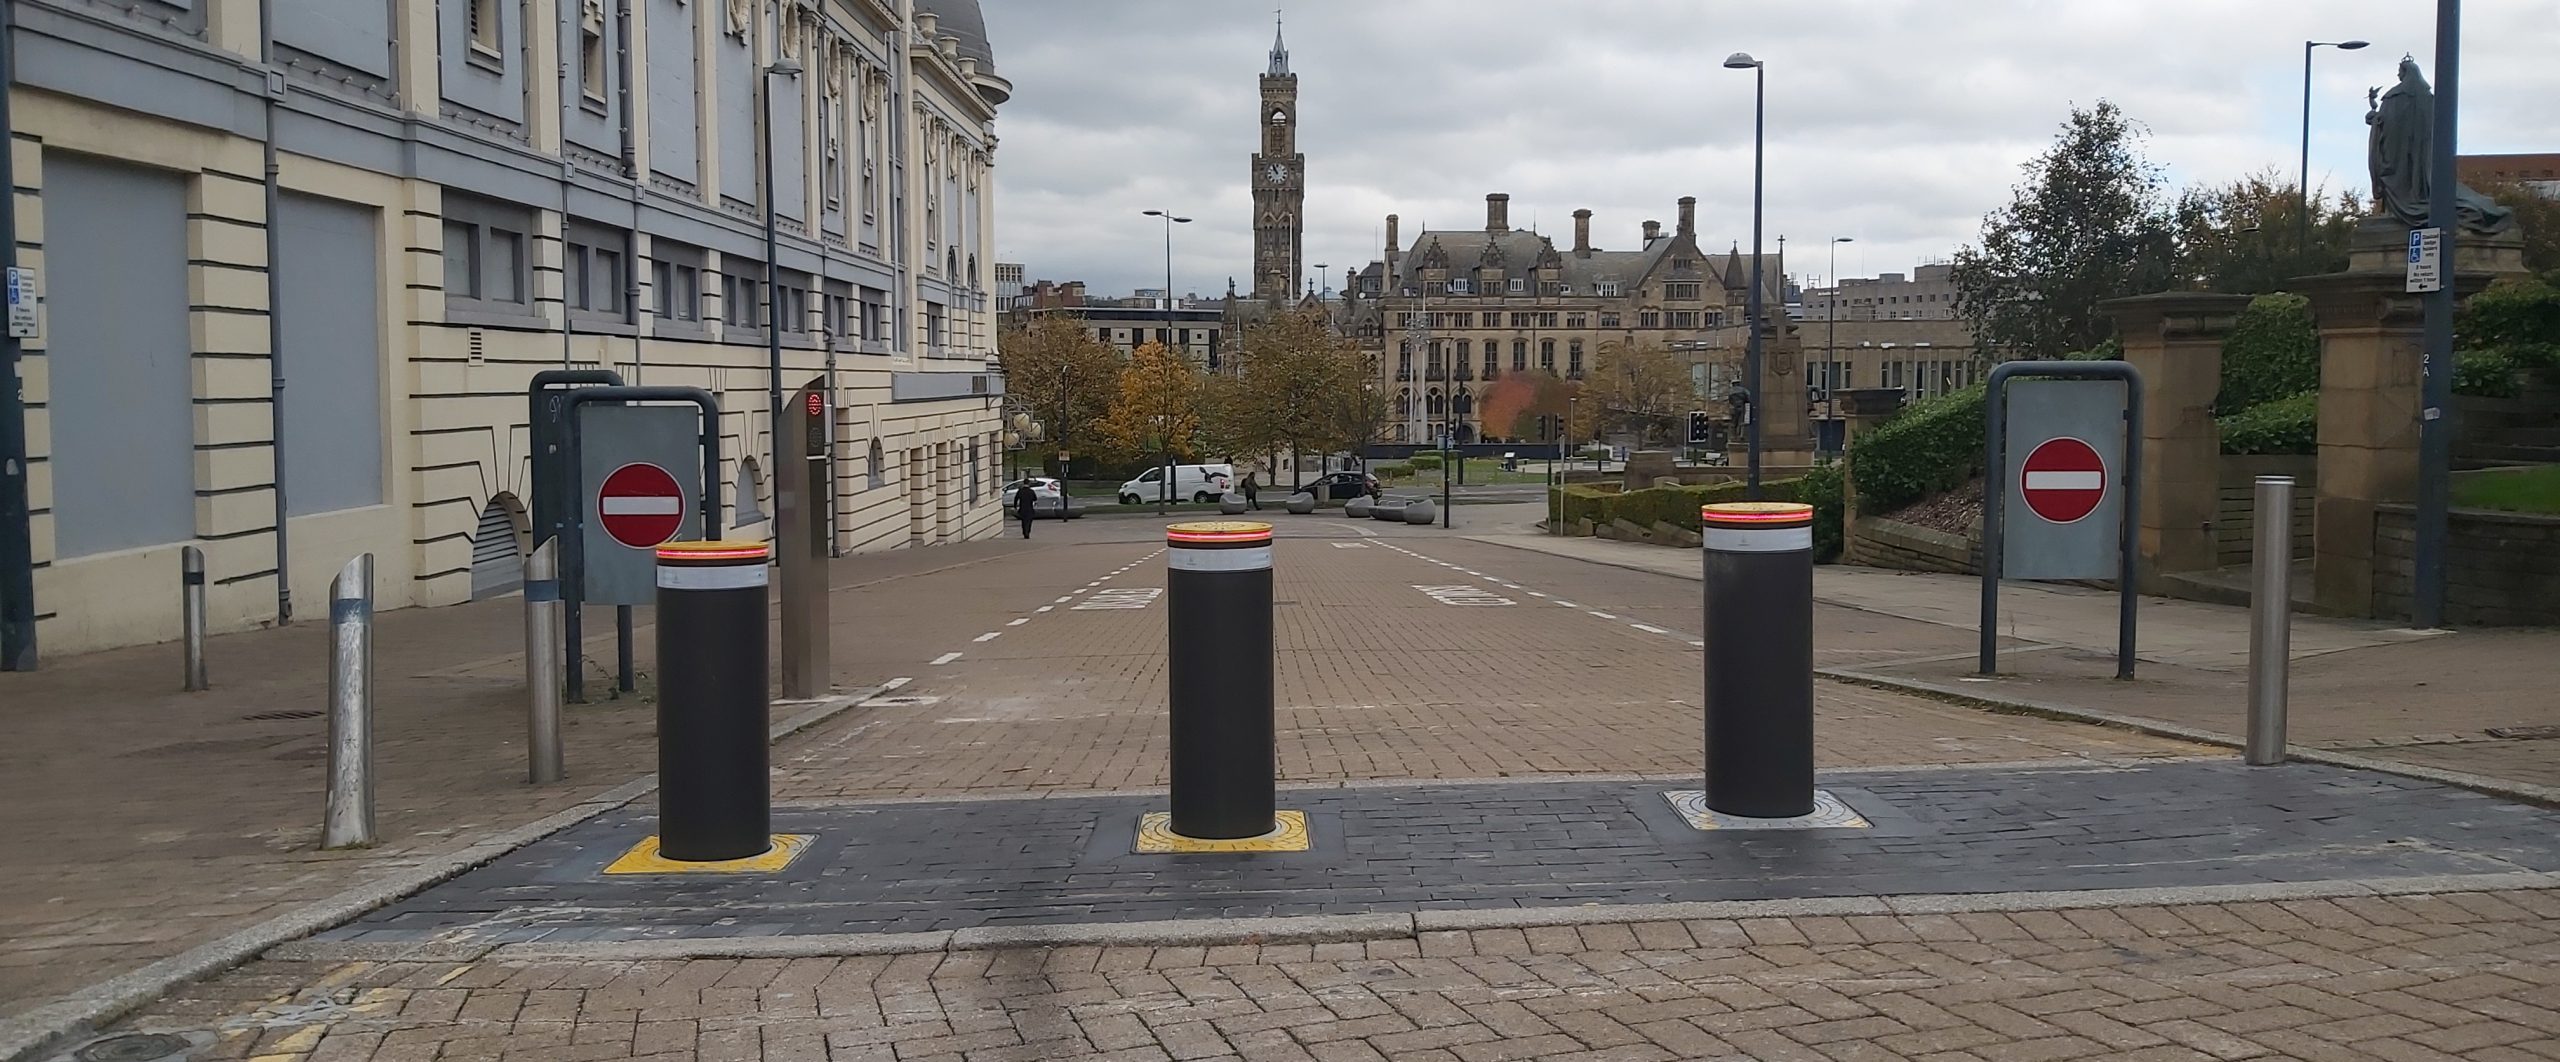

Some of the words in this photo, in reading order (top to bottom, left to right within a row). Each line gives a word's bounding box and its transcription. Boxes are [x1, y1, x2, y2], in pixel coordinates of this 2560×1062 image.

[2412, 233, 2420, 245] P
[2423, 353, 2430, 364] 2
[2422, 366, 2430, 377] A
